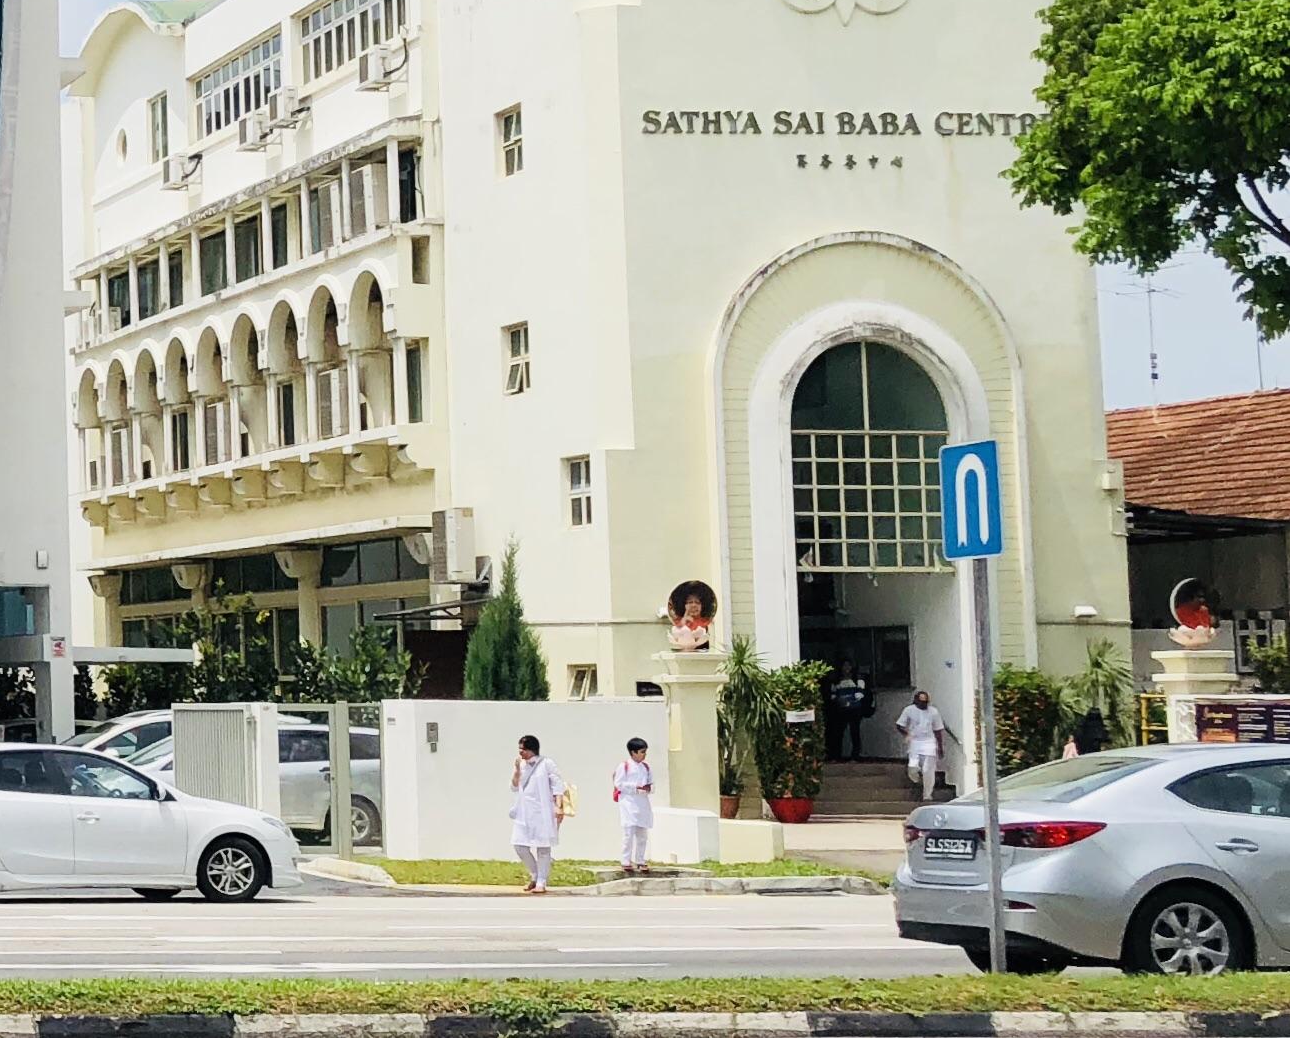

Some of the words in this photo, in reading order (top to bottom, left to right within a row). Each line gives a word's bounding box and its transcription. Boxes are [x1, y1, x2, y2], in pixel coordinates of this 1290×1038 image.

[641, 110, 762, 135] SATHYA
[773, 110, 826, 136] SAI
[835, 111, 922, 136] BABA
[934, 112, 1051, 137] CENTR
